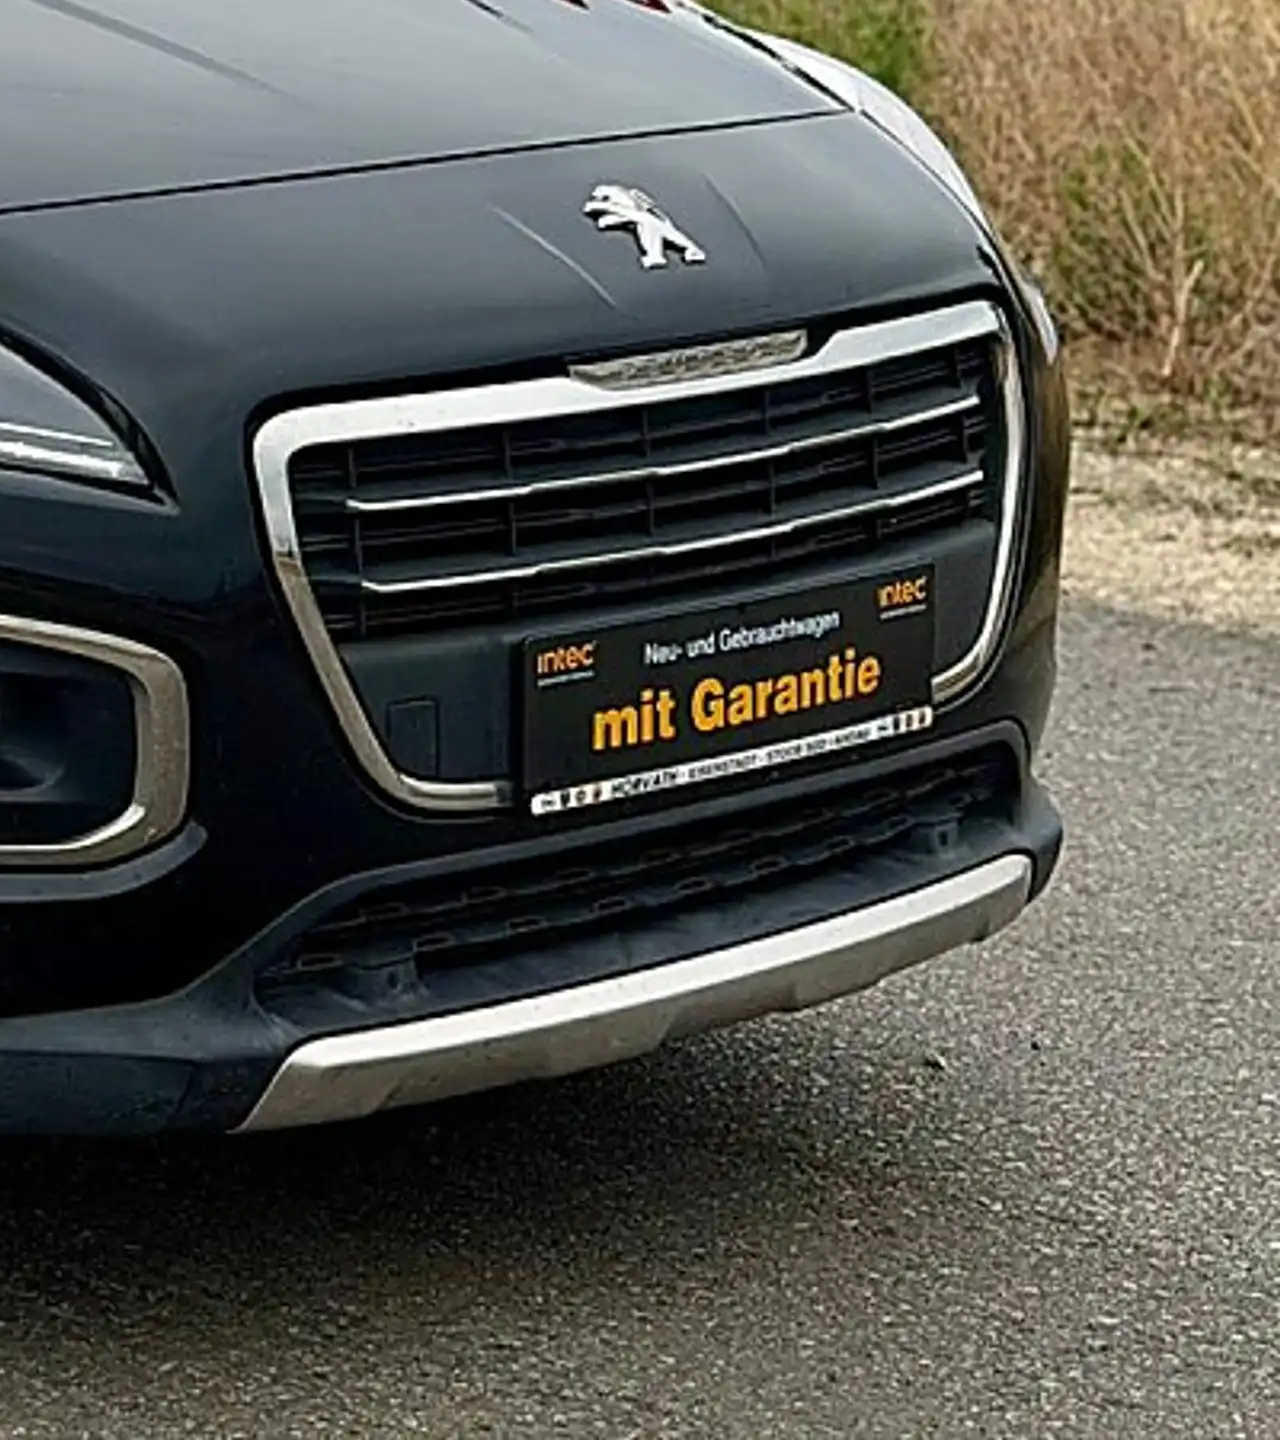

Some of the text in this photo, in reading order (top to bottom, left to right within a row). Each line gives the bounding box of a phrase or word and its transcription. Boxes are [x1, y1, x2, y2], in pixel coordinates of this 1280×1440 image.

[877, 577, 926, 608] intec
[536, 642, 594, 674] intec
[643, 611, 840, 665] Neu- und Gebrauchtwagen
[592, 648, 882, 750] mit Garantie
